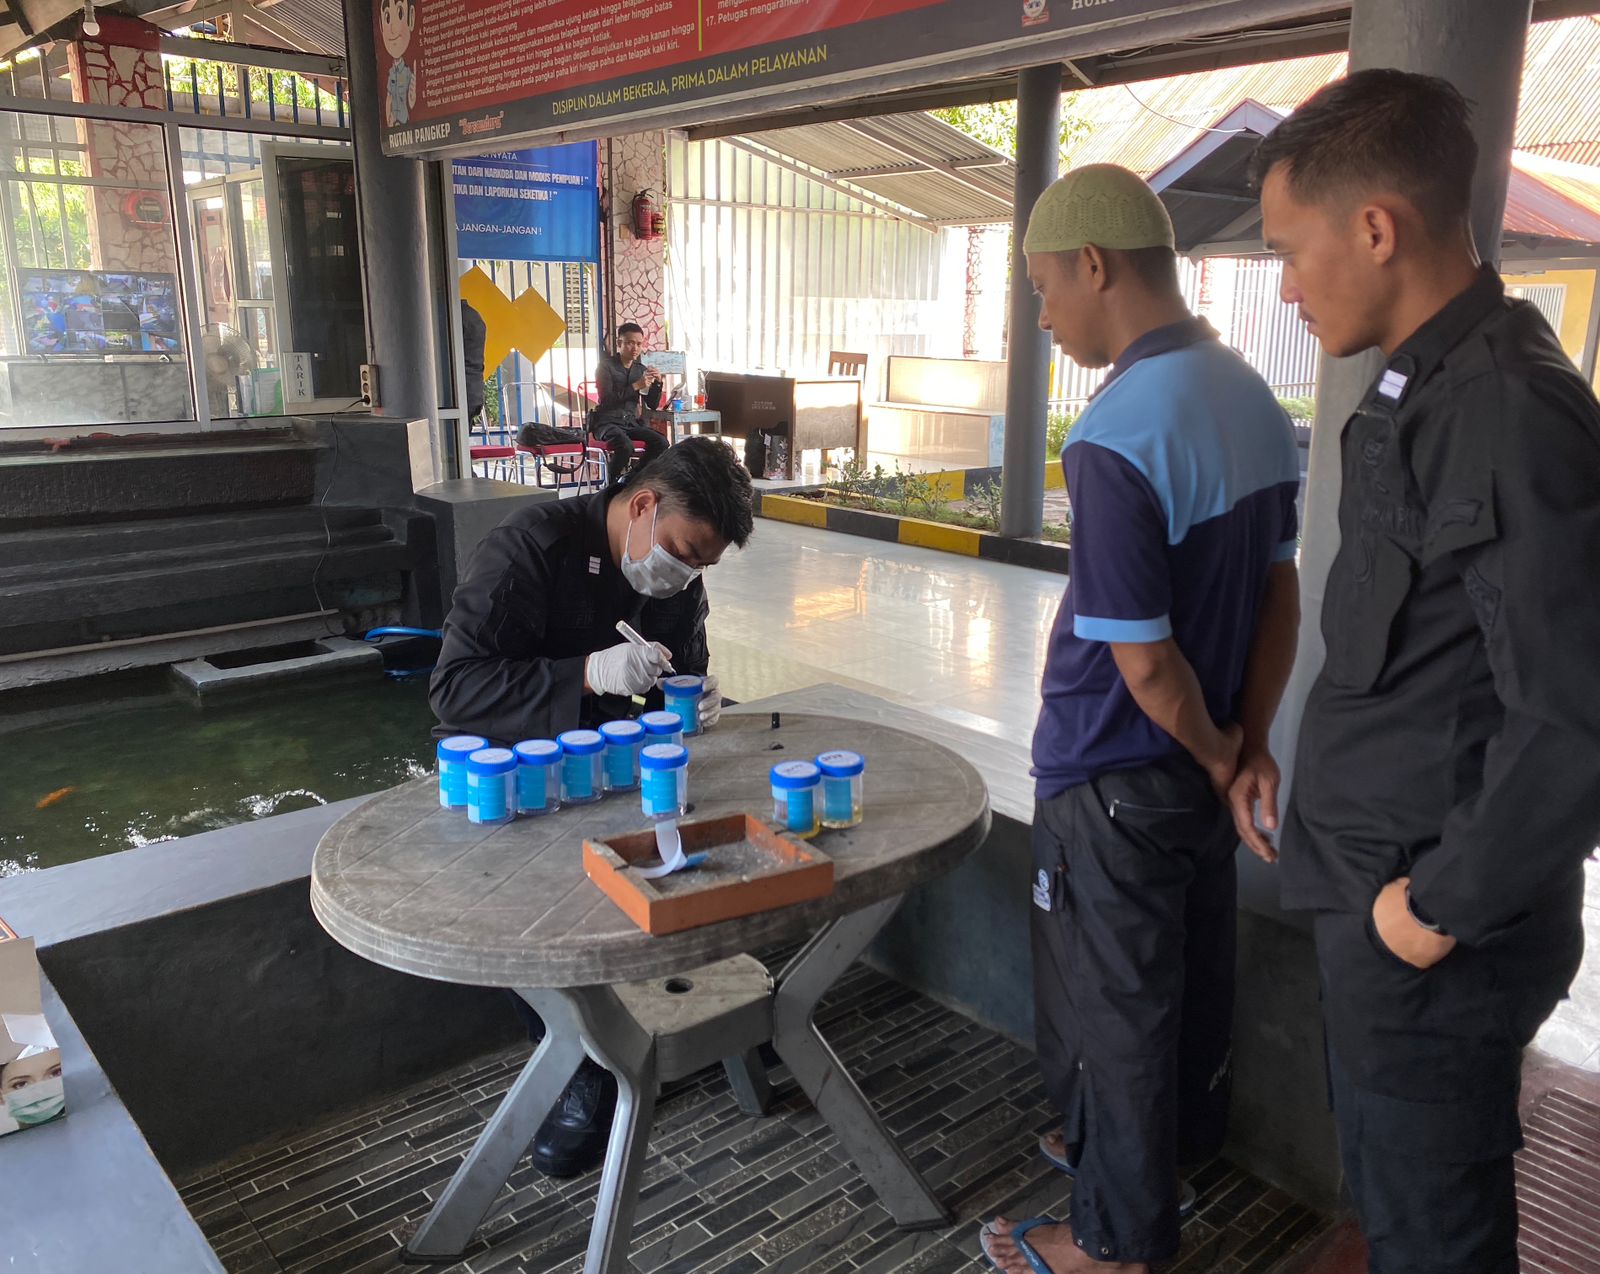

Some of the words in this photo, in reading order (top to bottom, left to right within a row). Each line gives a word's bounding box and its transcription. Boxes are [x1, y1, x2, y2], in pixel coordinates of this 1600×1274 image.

[600, 3, 622, 16] hingga
[614, 13, 630, 24] leher
[632, 7, 654, 18] hingga
[654, 2, 673, 12] batas
[705, 15, 716, 26] 17.
[718, 8, 748, 23] Petugas
[625, 39, 632, 47] ke
[634, 34, 649, 47] paha
[650, 29, 670, 40] kanan
[671, 22, 695, 35] hingga
[616, 52, 627, 62] dan
[628, 45, 651, 58] telapak
[652, 42, 666, 53] kaki
[667, 39, 680, 49] kiri.
[552, 96, 588, 115] DISIPLIN
[589, 88, 621, 108] DALAM
[623, 79, 669, 101] BEKERJA,
[671, 71, 706, 91] PRIMA
[707, 61, 749, 84] DALAM
[751, 44, 827, 75] PELAYANAN
[388, 130, 413, 148] RUTAN
[414, 122, 451, 143] PANGKEP
[490, 151, 518, 160] NYATA
[468, 166, 483, 177] DARI
[484, 167, 514, 179] NARKOBA
[514, 170, 527, 180] DAN
[528, 171, 551, 182] MODUS
[470, 185, 483, 195] DAN
[484, 186, 518, 198] LAPORKAN
[519, 188, 548, 201] SEKETIKA
[461, 223, 537, 235] JANGAN-JANGAN
[294, 355, 305, 396] TARIK
